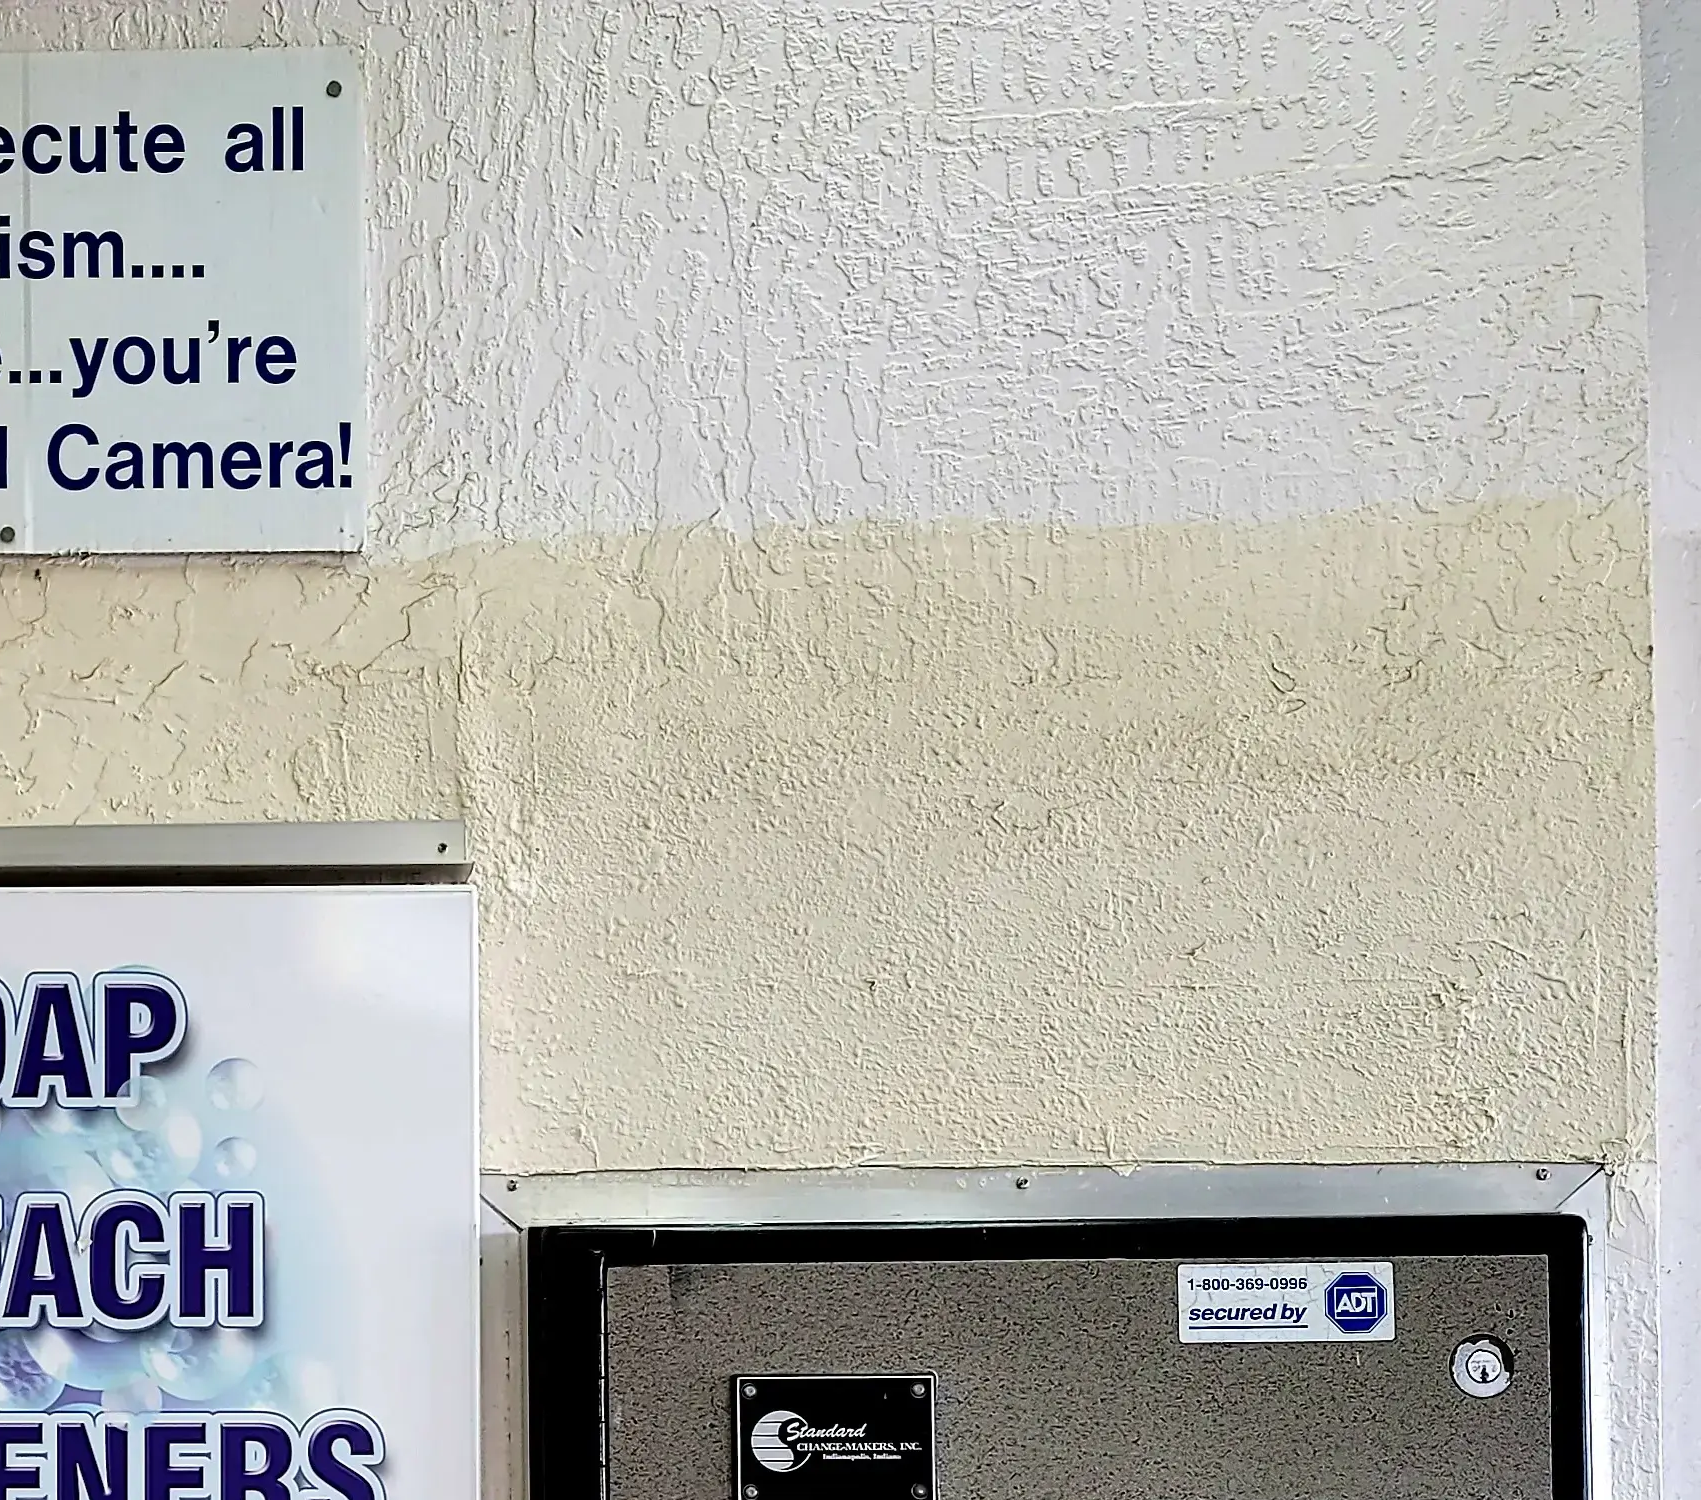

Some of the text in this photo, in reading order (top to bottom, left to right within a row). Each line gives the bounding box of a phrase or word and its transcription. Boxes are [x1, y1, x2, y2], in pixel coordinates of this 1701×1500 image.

[224, 106, 305, 172] all
[48, 422, 354, 490] Camera!
[1187, 1278, 1308, 1291] 1-800-369-0996
[1335, 1291, 1377, 1313] ADT
[1189, 1303, 1308, 1323] secured by
[786, 1422, 867, 1441] Standard
[796, 1442, 923, 1452] CHANGE-MAKERS, INC.
